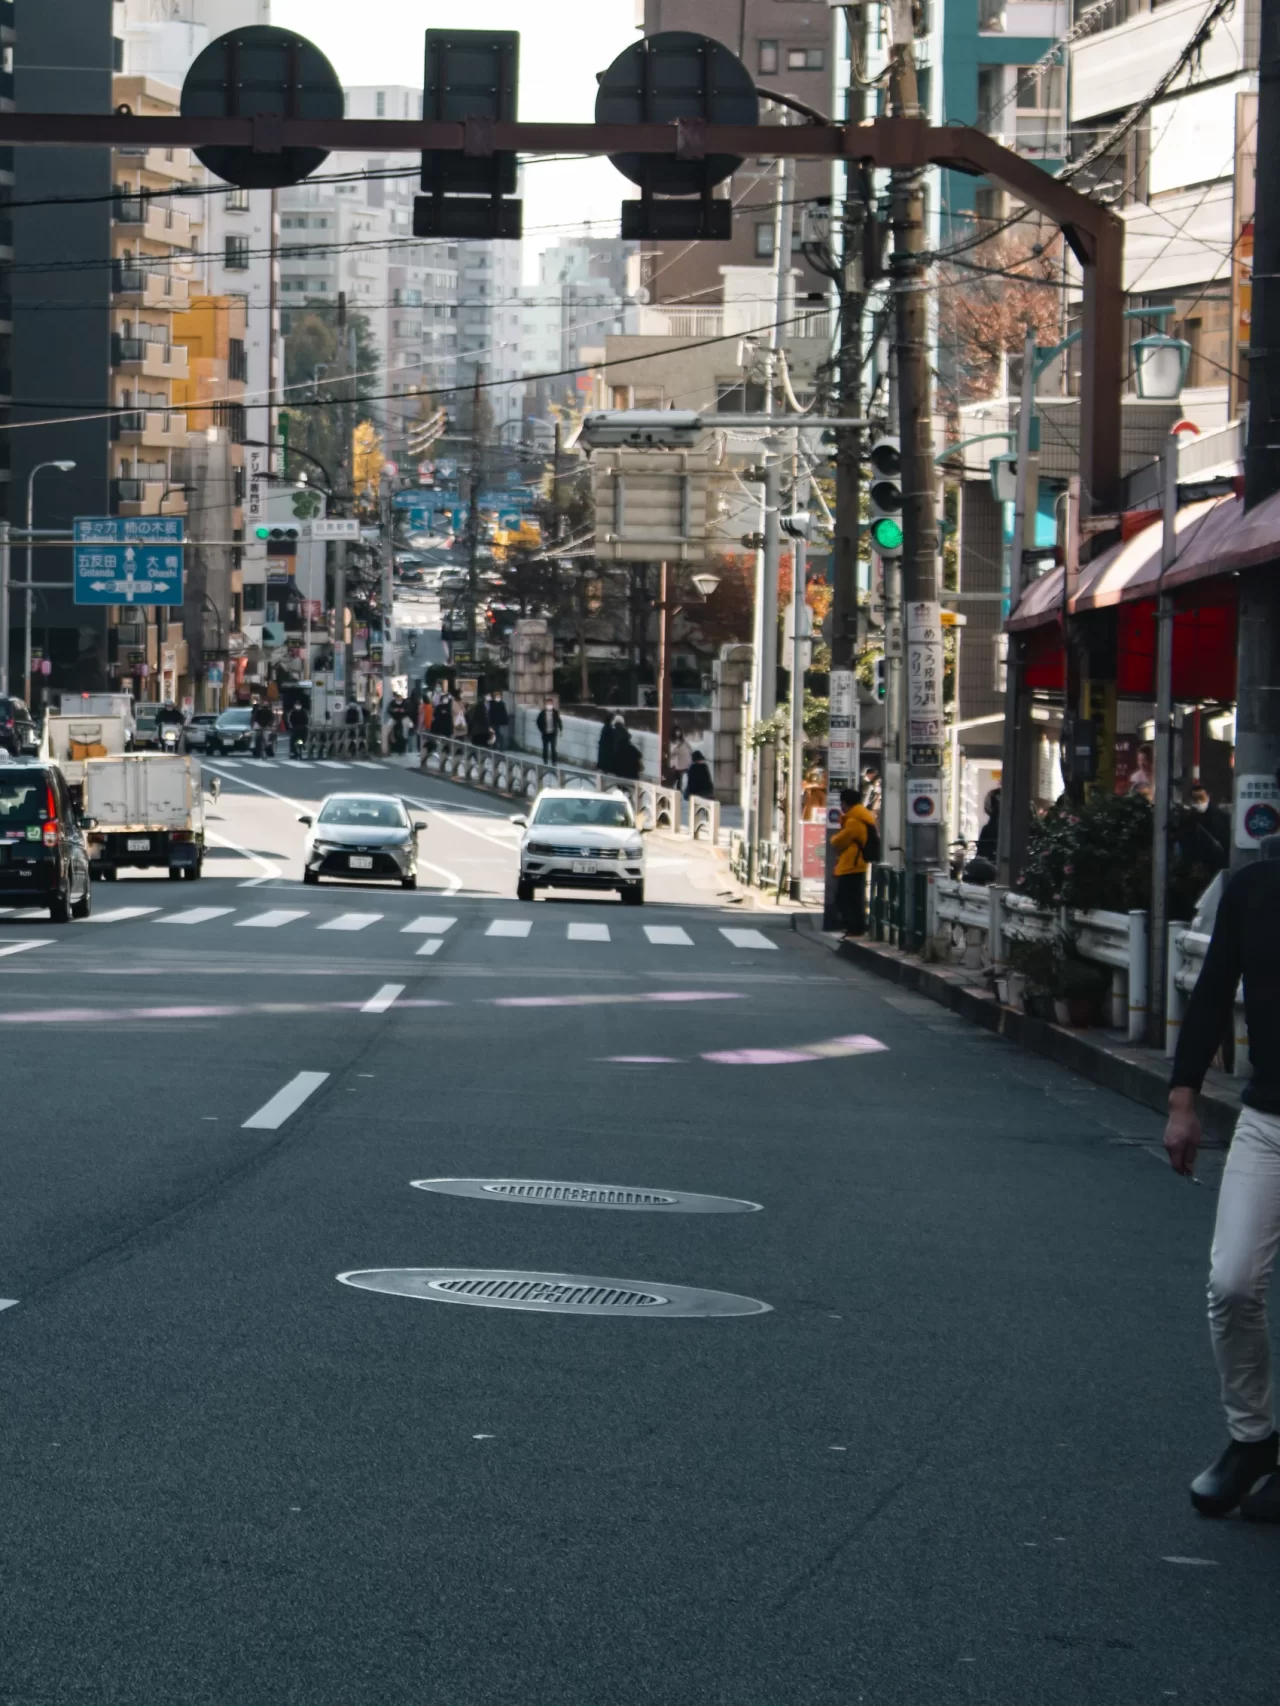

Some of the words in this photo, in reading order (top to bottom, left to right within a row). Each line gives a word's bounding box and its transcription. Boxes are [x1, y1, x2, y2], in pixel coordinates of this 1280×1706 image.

[78, 555, 117, 568] 五反田
[911, 652, 923, 706] クリニック
